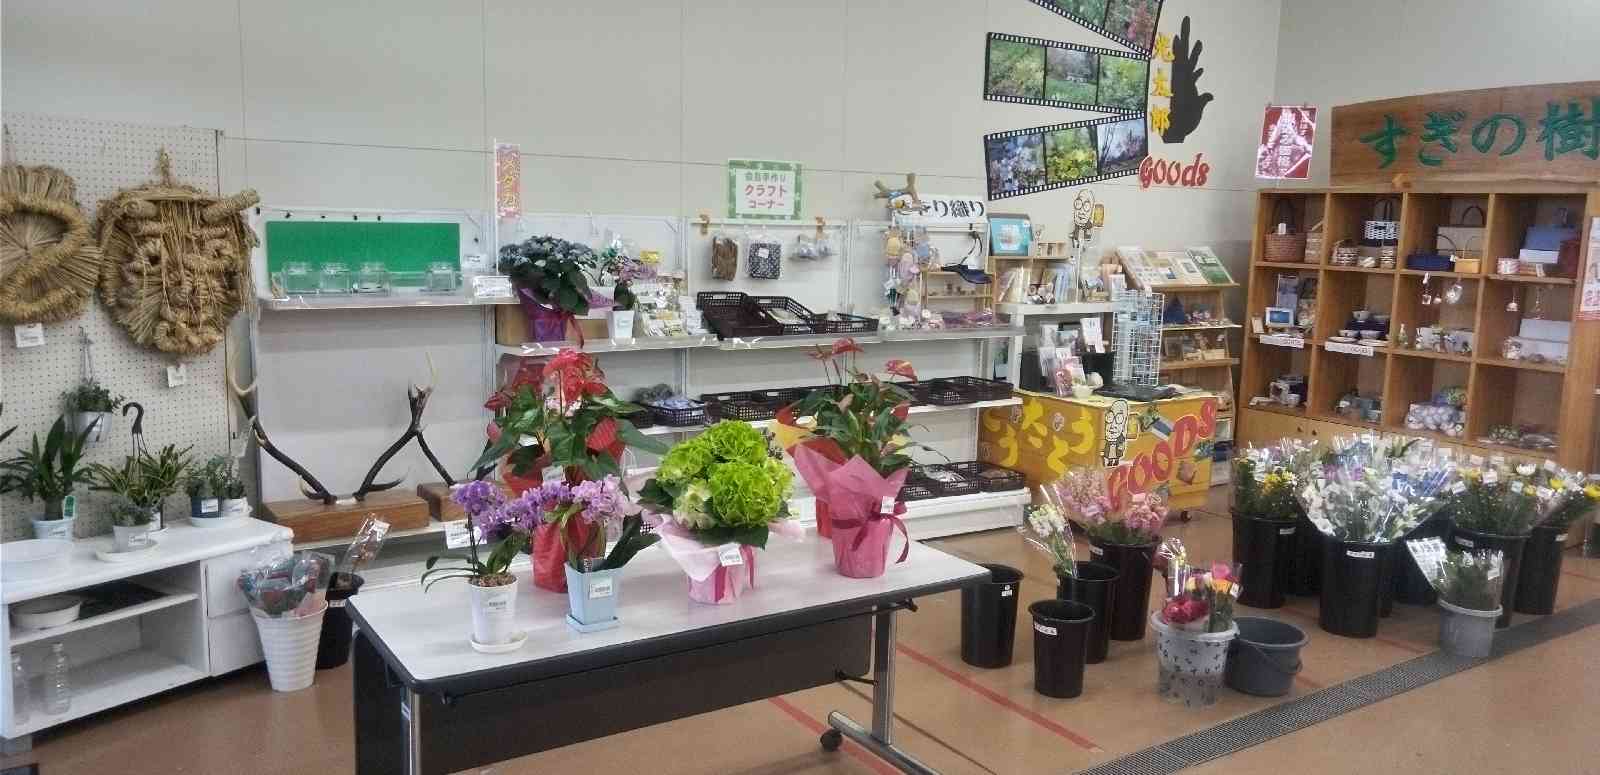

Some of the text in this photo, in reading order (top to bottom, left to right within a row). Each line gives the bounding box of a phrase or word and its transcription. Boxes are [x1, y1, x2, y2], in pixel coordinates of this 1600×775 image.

[744, 184, 787, 198] クラフト
[748, 199, 785, 209] コーナー
[1107, 400, 1216, 512] GOODS
